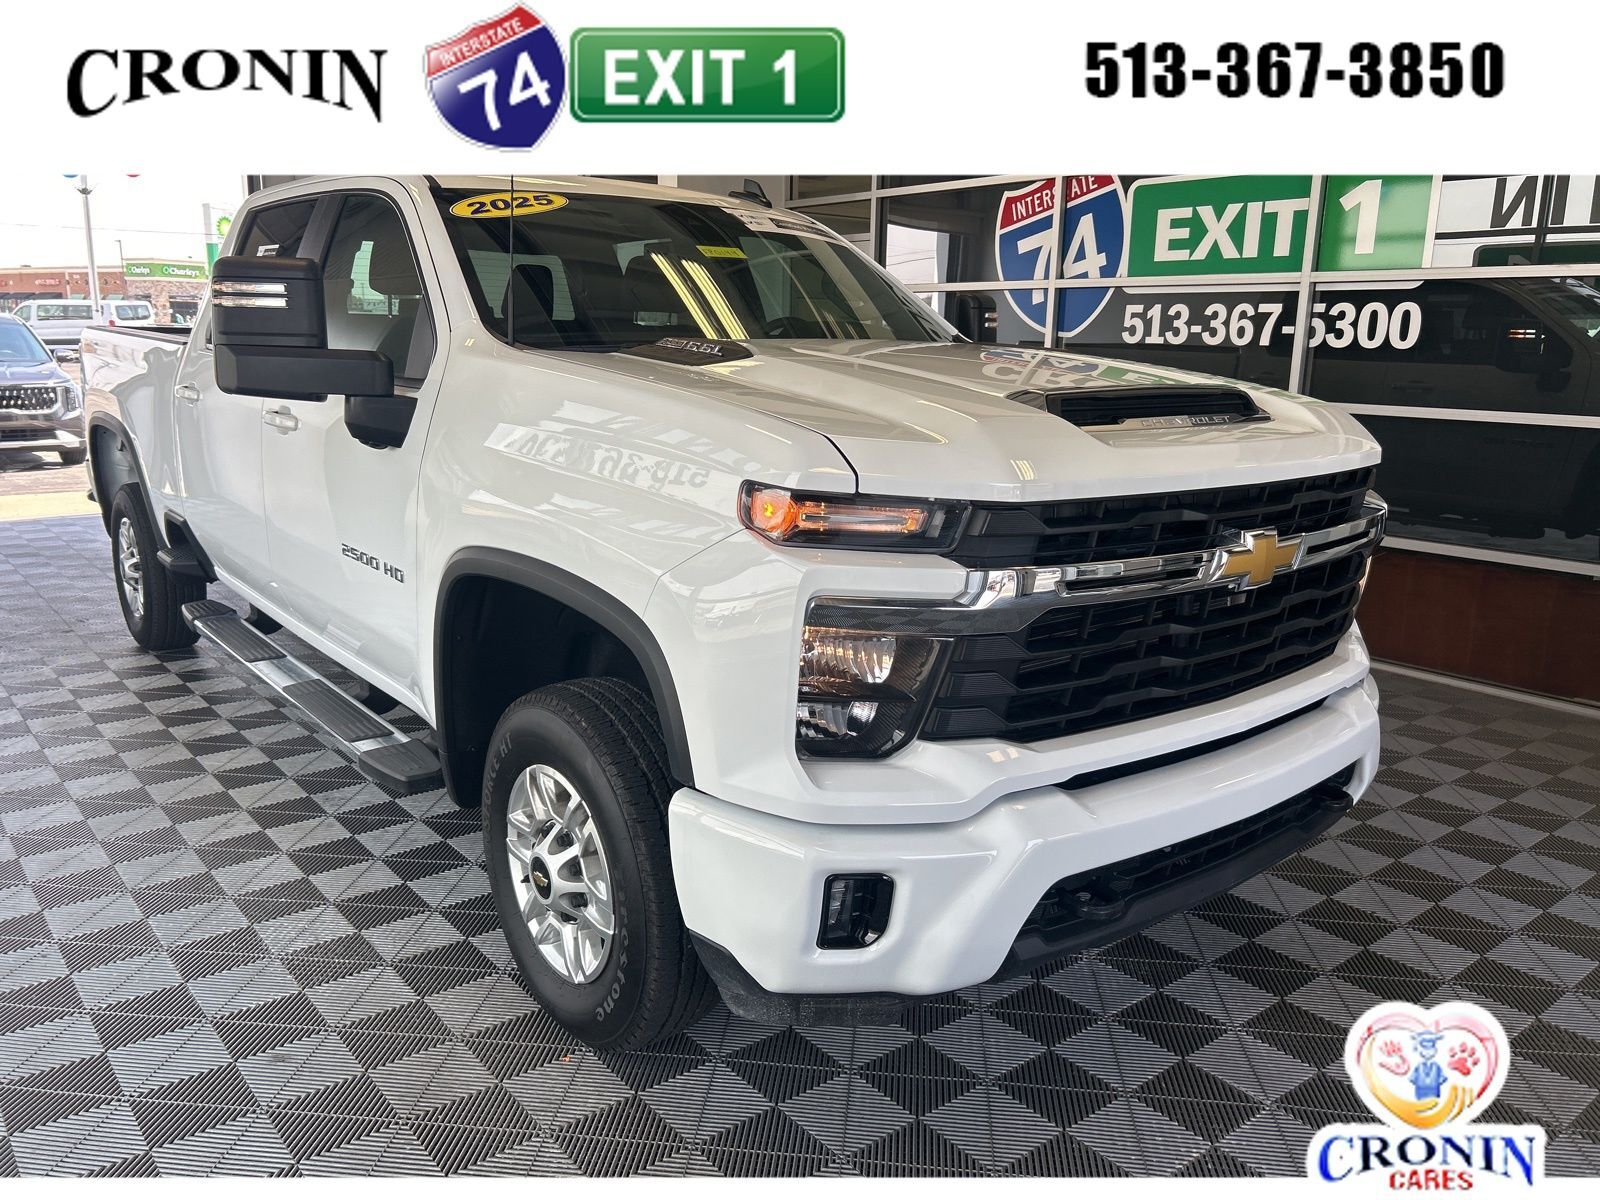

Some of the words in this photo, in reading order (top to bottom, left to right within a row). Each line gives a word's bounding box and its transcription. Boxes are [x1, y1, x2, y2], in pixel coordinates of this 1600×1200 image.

[467, 195, 554, 215] 2025
[1154, 197, 1310, 262] EXIT
[1339, 179, 1383, 255] 1
[1016, 212, 1107, 306] 74
[1121, 301, 1422, 350] 513-367-5300
[1141, 415, 1230, 428] CHEVROLET
[341, 543, 380, 571] 2500
